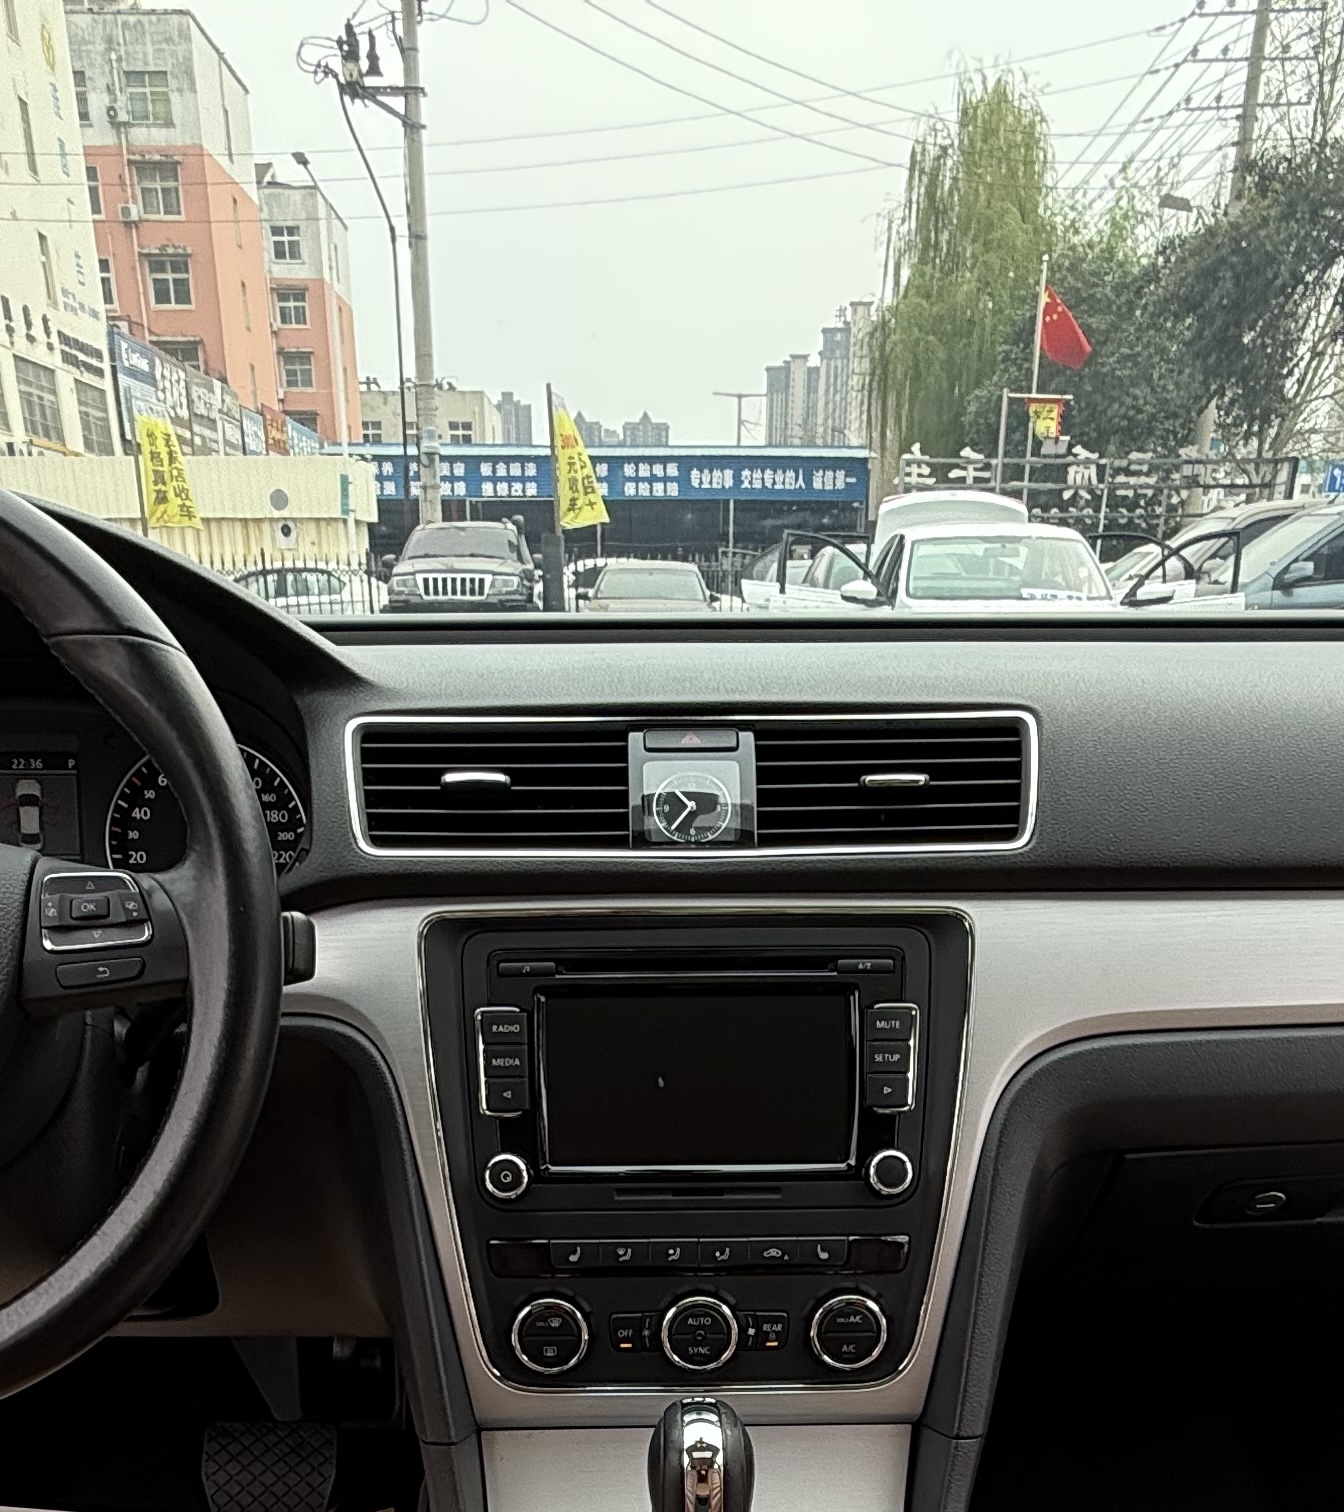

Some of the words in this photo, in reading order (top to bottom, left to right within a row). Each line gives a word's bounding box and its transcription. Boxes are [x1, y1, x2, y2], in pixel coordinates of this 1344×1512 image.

[480, 462, 537, 477] 钣金喷漆
[690, 468, 734, 489] 专业的事
[740, 468, 806, 490] 交给专业的人
[812, 469, 857, 491] 诚信第一
[624, 482, 679, 497] 保险理赔
[67, 758, 76, 769] P
[158, 774, 168, 786] 6
[143, 789, 156, 800] 50
[131, 807, 151, 821] 40
[264, 810, 289, 823] 180
[277, 832, 295, 841] 200
[128, 851, 147, 864] 20
[80, 901, 97, 913] OK
[491, 1024, 520, 1033] RADIO
[876, 1019, 900, 1029] MUTE
[491, 1057, 521, 1067] MEDIA
[874, 1053, 901, 1062] SETUP
[687, 1317, 712, 1326] AUTO
[762, 1323, 783, 1332] REAR
[617, 1329, 634, 1338] OFF
[687, 1346, 711, 1355] SYNC
[841, 1344, 857, 1353] A/C
